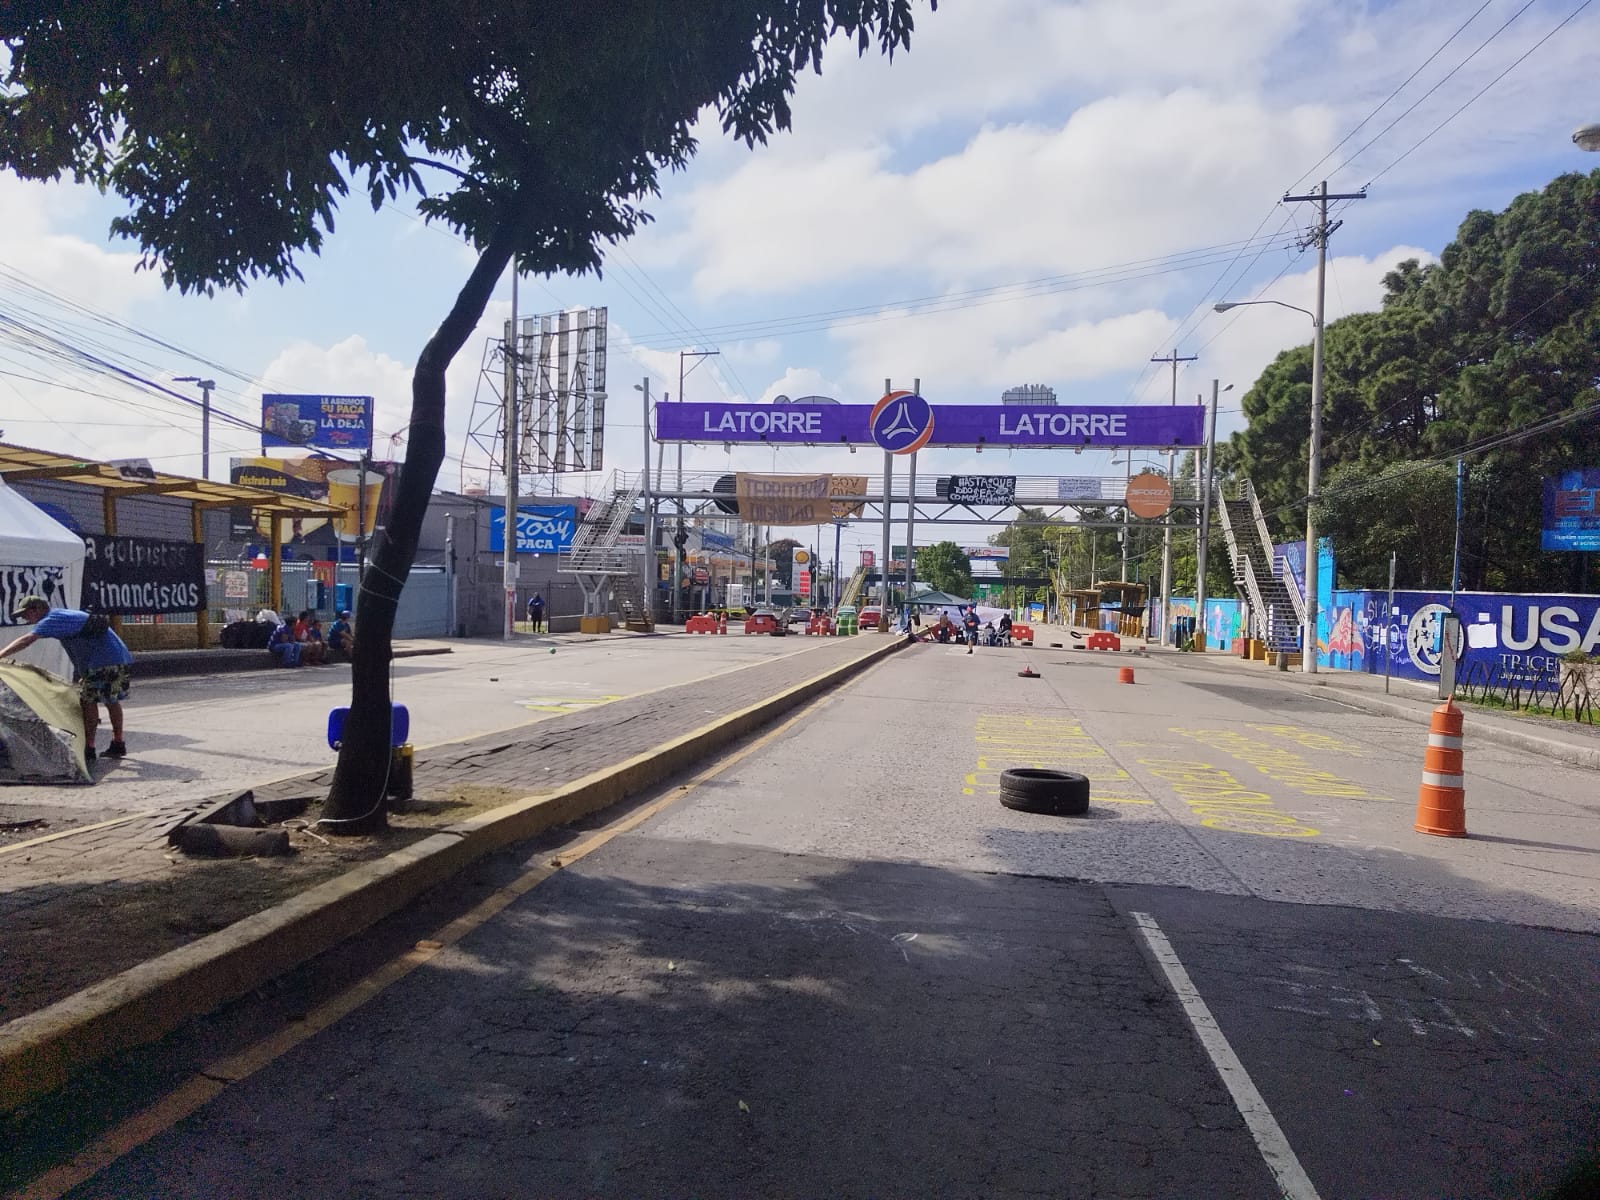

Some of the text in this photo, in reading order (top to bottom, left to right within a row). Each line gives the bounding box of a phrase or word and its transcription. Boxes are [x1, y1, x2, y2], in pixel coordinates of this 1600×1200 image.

[321, 405, 365, 414] SU PACA
[321, 418, 366, 429] LA DEJA
[704, 411, 822, 434] LATORRE
[1000, 413, 1127, 436] LATORRE
[958, 477, 1013, 487] HASTA QUE
[950, 493, 974, 501] COMO
[516, 539, 554, 549] PACA
